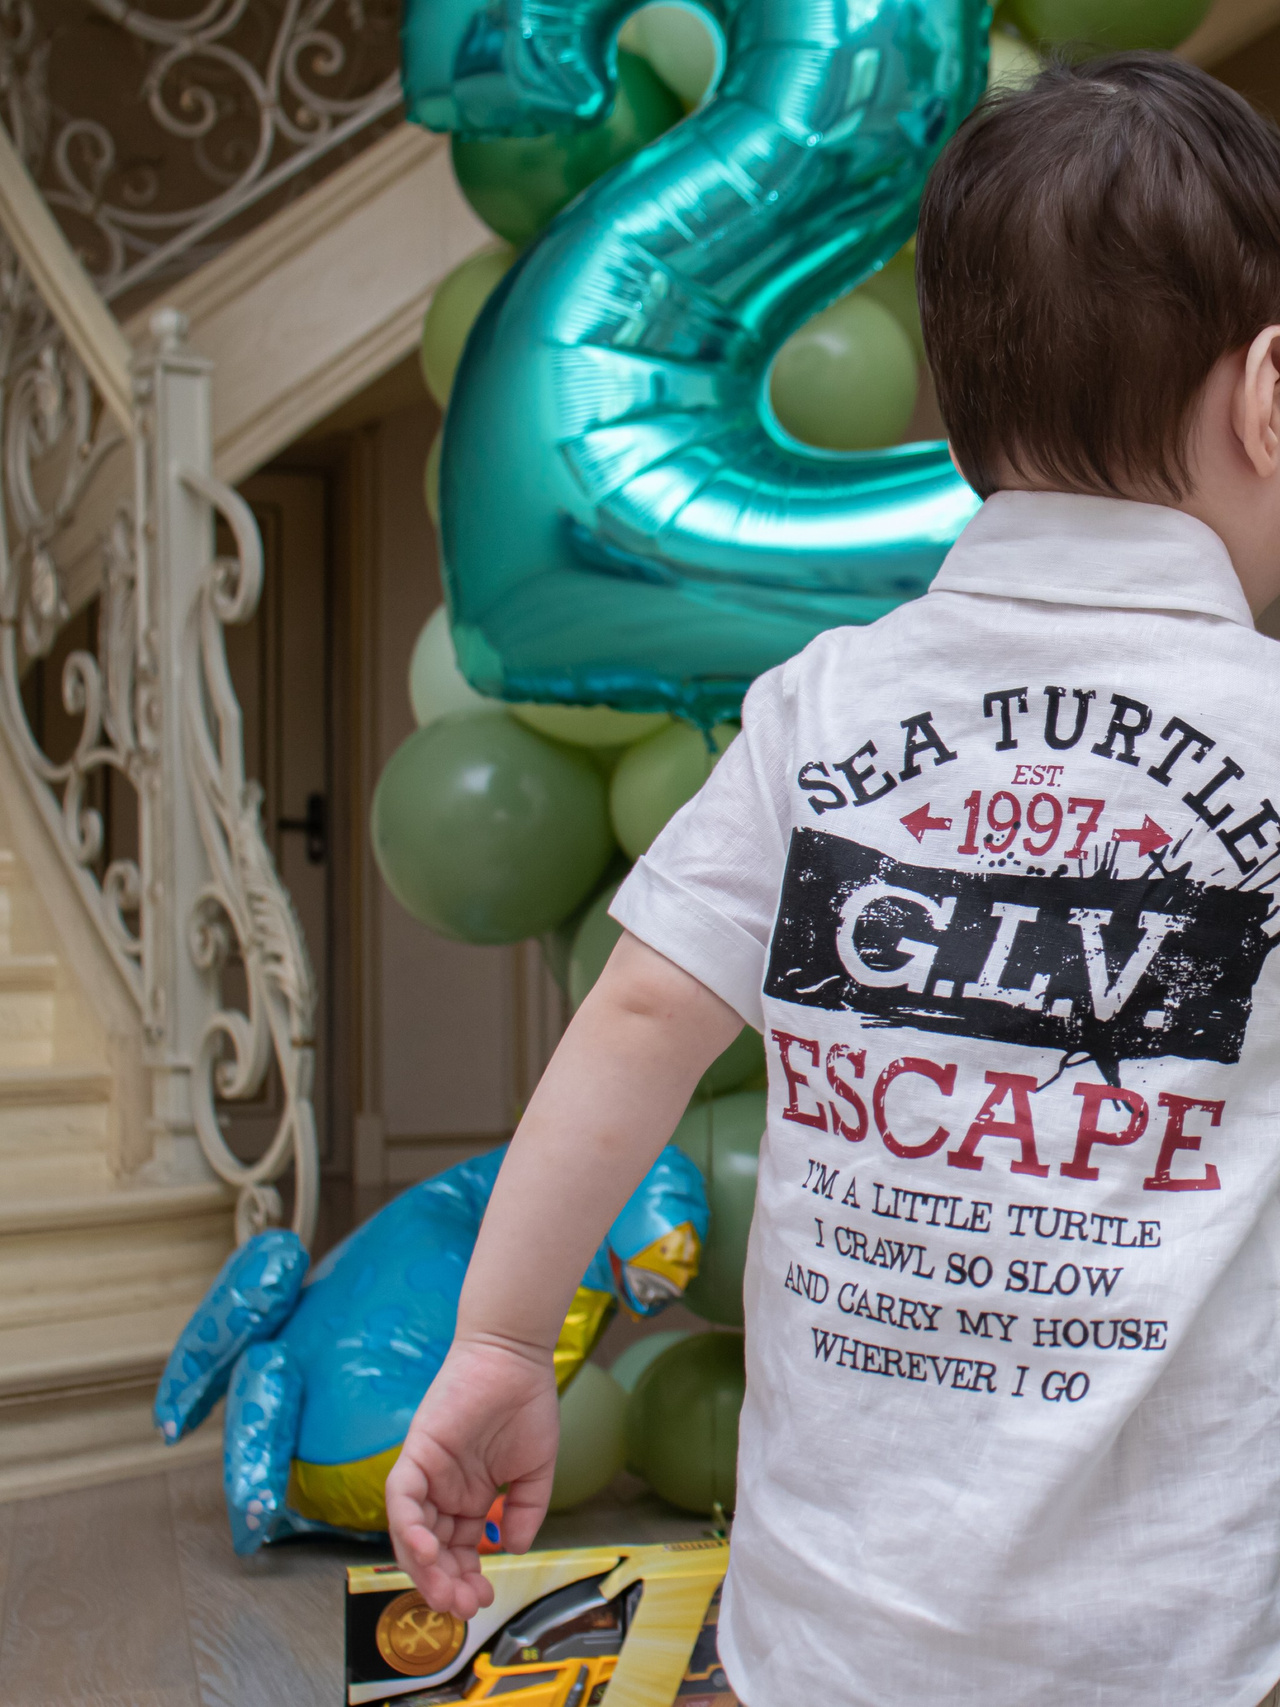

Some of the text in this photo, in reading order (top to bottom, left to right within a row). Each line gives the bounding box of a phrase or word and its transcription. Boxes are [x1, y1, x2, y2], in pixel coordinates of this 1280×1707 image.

[399, 0, 990, 708] 2
[798, 711, 957, 815] SEA
[1011, 765, 1064, 786] EST.
[958, 790, 1105, 859] 1997
[836, 882, 1189, 1029] G.L.V.
[771, 1029, 1226, 1191] ESCAPE
[802, 1159, 1161, 1248] I'M A LITTLE TURTLE
[813, 1217, 1124, 1297] I CRAWL SO SLOW
[785, 1262, 1167, 1350] AND CARRY MY HOUSE
[811, 1327, 1090, 1402] WHEREVER I GO
